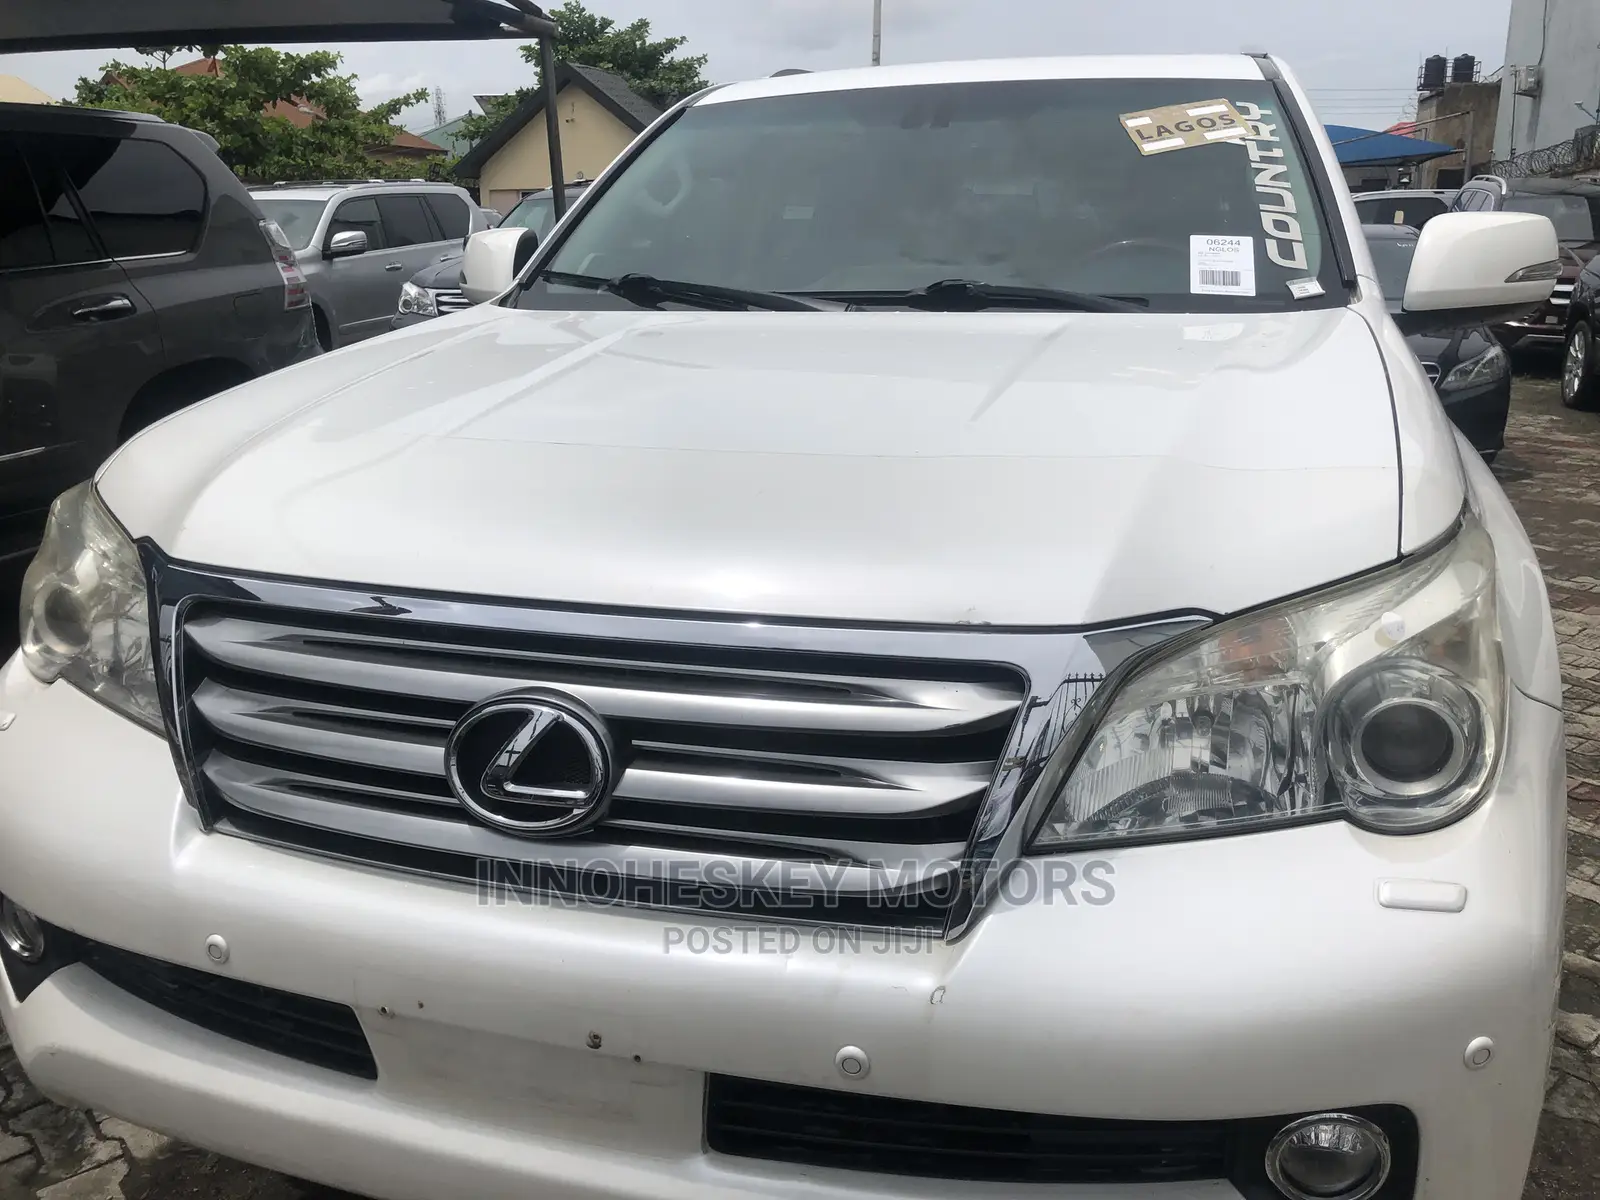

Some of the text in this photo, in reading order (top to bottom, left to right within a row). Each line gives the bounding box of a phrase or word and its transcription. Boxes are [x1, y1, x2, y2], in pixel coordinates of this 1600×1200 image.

[1135, 113, 1236, 141] LAGOS
[1233, 101, 1308, 270] COUNTRY
[1206, 238, 1241, 246] 06244
